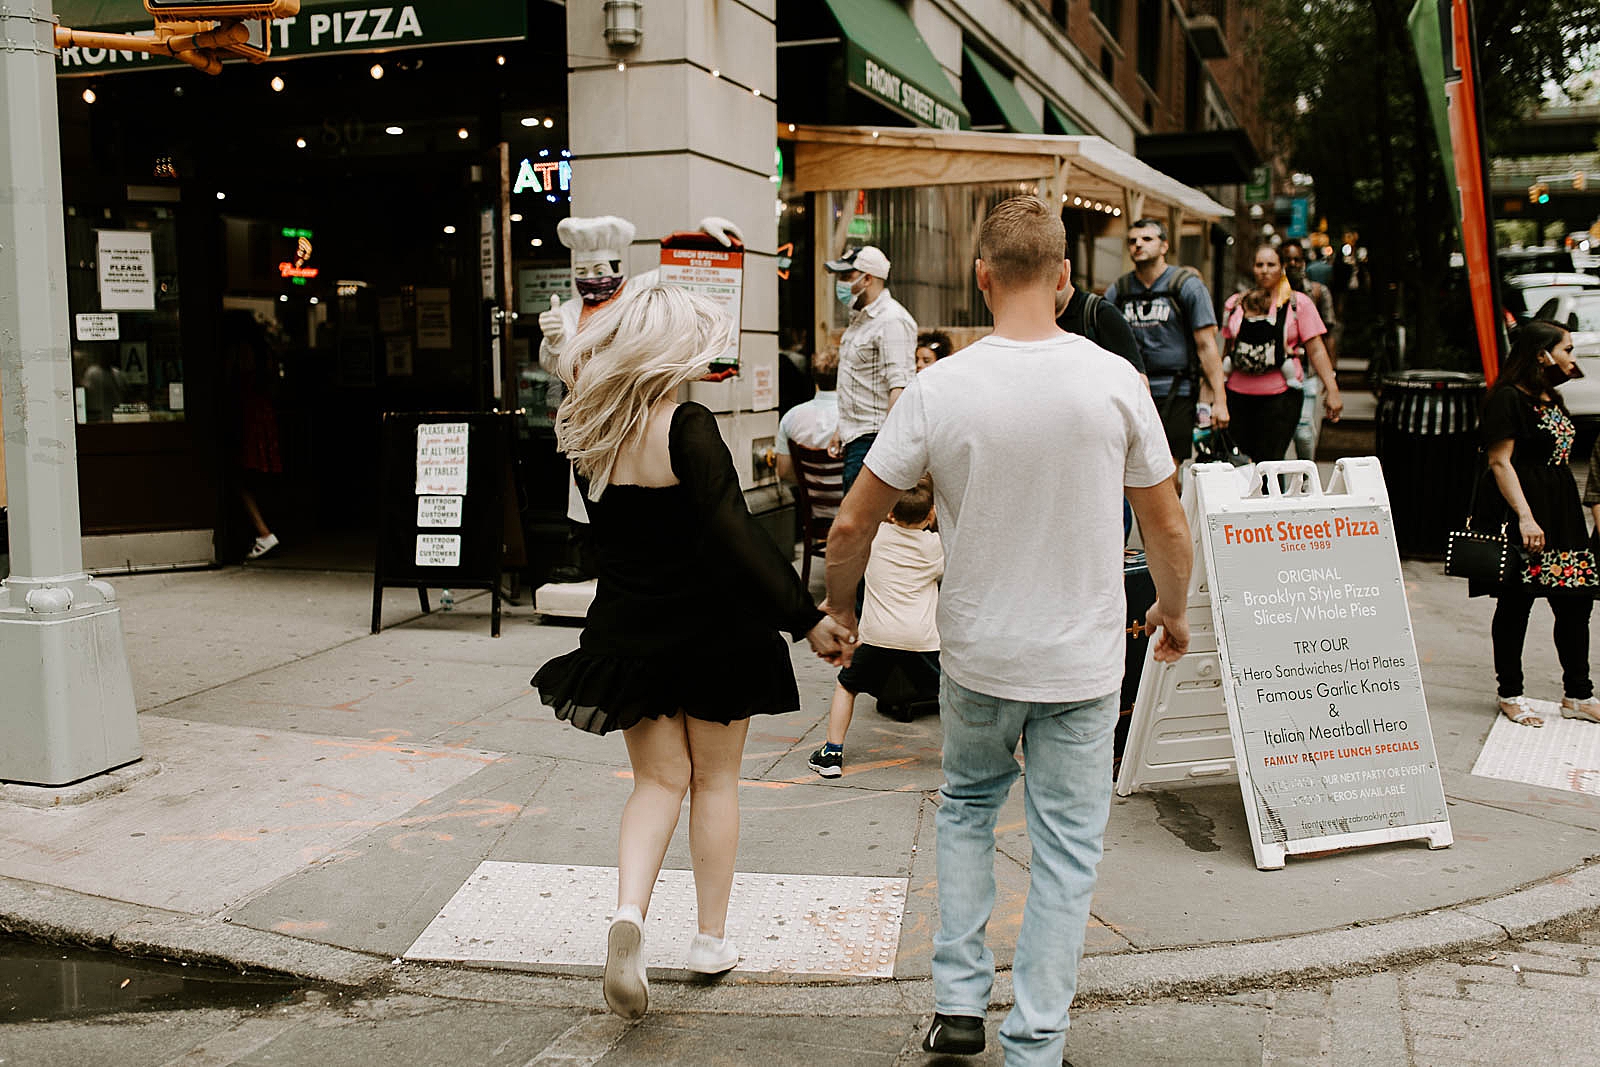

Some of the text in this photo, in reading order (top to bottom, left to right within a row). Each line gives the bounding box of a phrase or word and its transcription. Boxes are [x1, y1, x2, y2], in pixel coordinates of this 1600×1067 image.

[62, 29, 155, 66] RONT
[310, 6, 423, 46] PIZZA
[865, 59, 901, 104] FRONT
[901, 82, 934, 123] STREET
[126, 347, 143, 372] A
[420, 425, 465, 435] PLEASE WEAR
[421, 446, 465, 456] AT ALL TIMES
[424, 467, 459, 476] AT TABLES
[1224, 516, 1380, 545] Front Street Pizza
[1280, 541, 1331, 552] Since 1989
[1277, 567, 1342, 584] ORIGINAL
[1243, 583, 1380, 606] Brooklyn Style Pizza
[1350, 602, 1377, 617] Pies
[1294, 637, 1350, 655] TRY OUR
[1243, 667, 1273, 681] Hero
[1373, 656, 1406, 670] Plates
[1257, 678, 1400, 703] Famous Garlic Knots
[1328, 703, 1340, 718] &
[1264, 717, 1408, 745] Italian Meatball Hero
[1264, 741, 1420, 767] FAMILY RECIPE LUNCH SPECIALS
[1320, 774, 1338, 786] OUR
[1340, 771, 1361, 785] NEXT
[1362, 768, 1386, 782] PARTY
[1387, 766, 1400, 778] OR
[1400, 764, 1427, 776] EVENT
[1328, 789, 1359, 803] EROS
[1360, 783, 1407, 799] AVAILABLE
